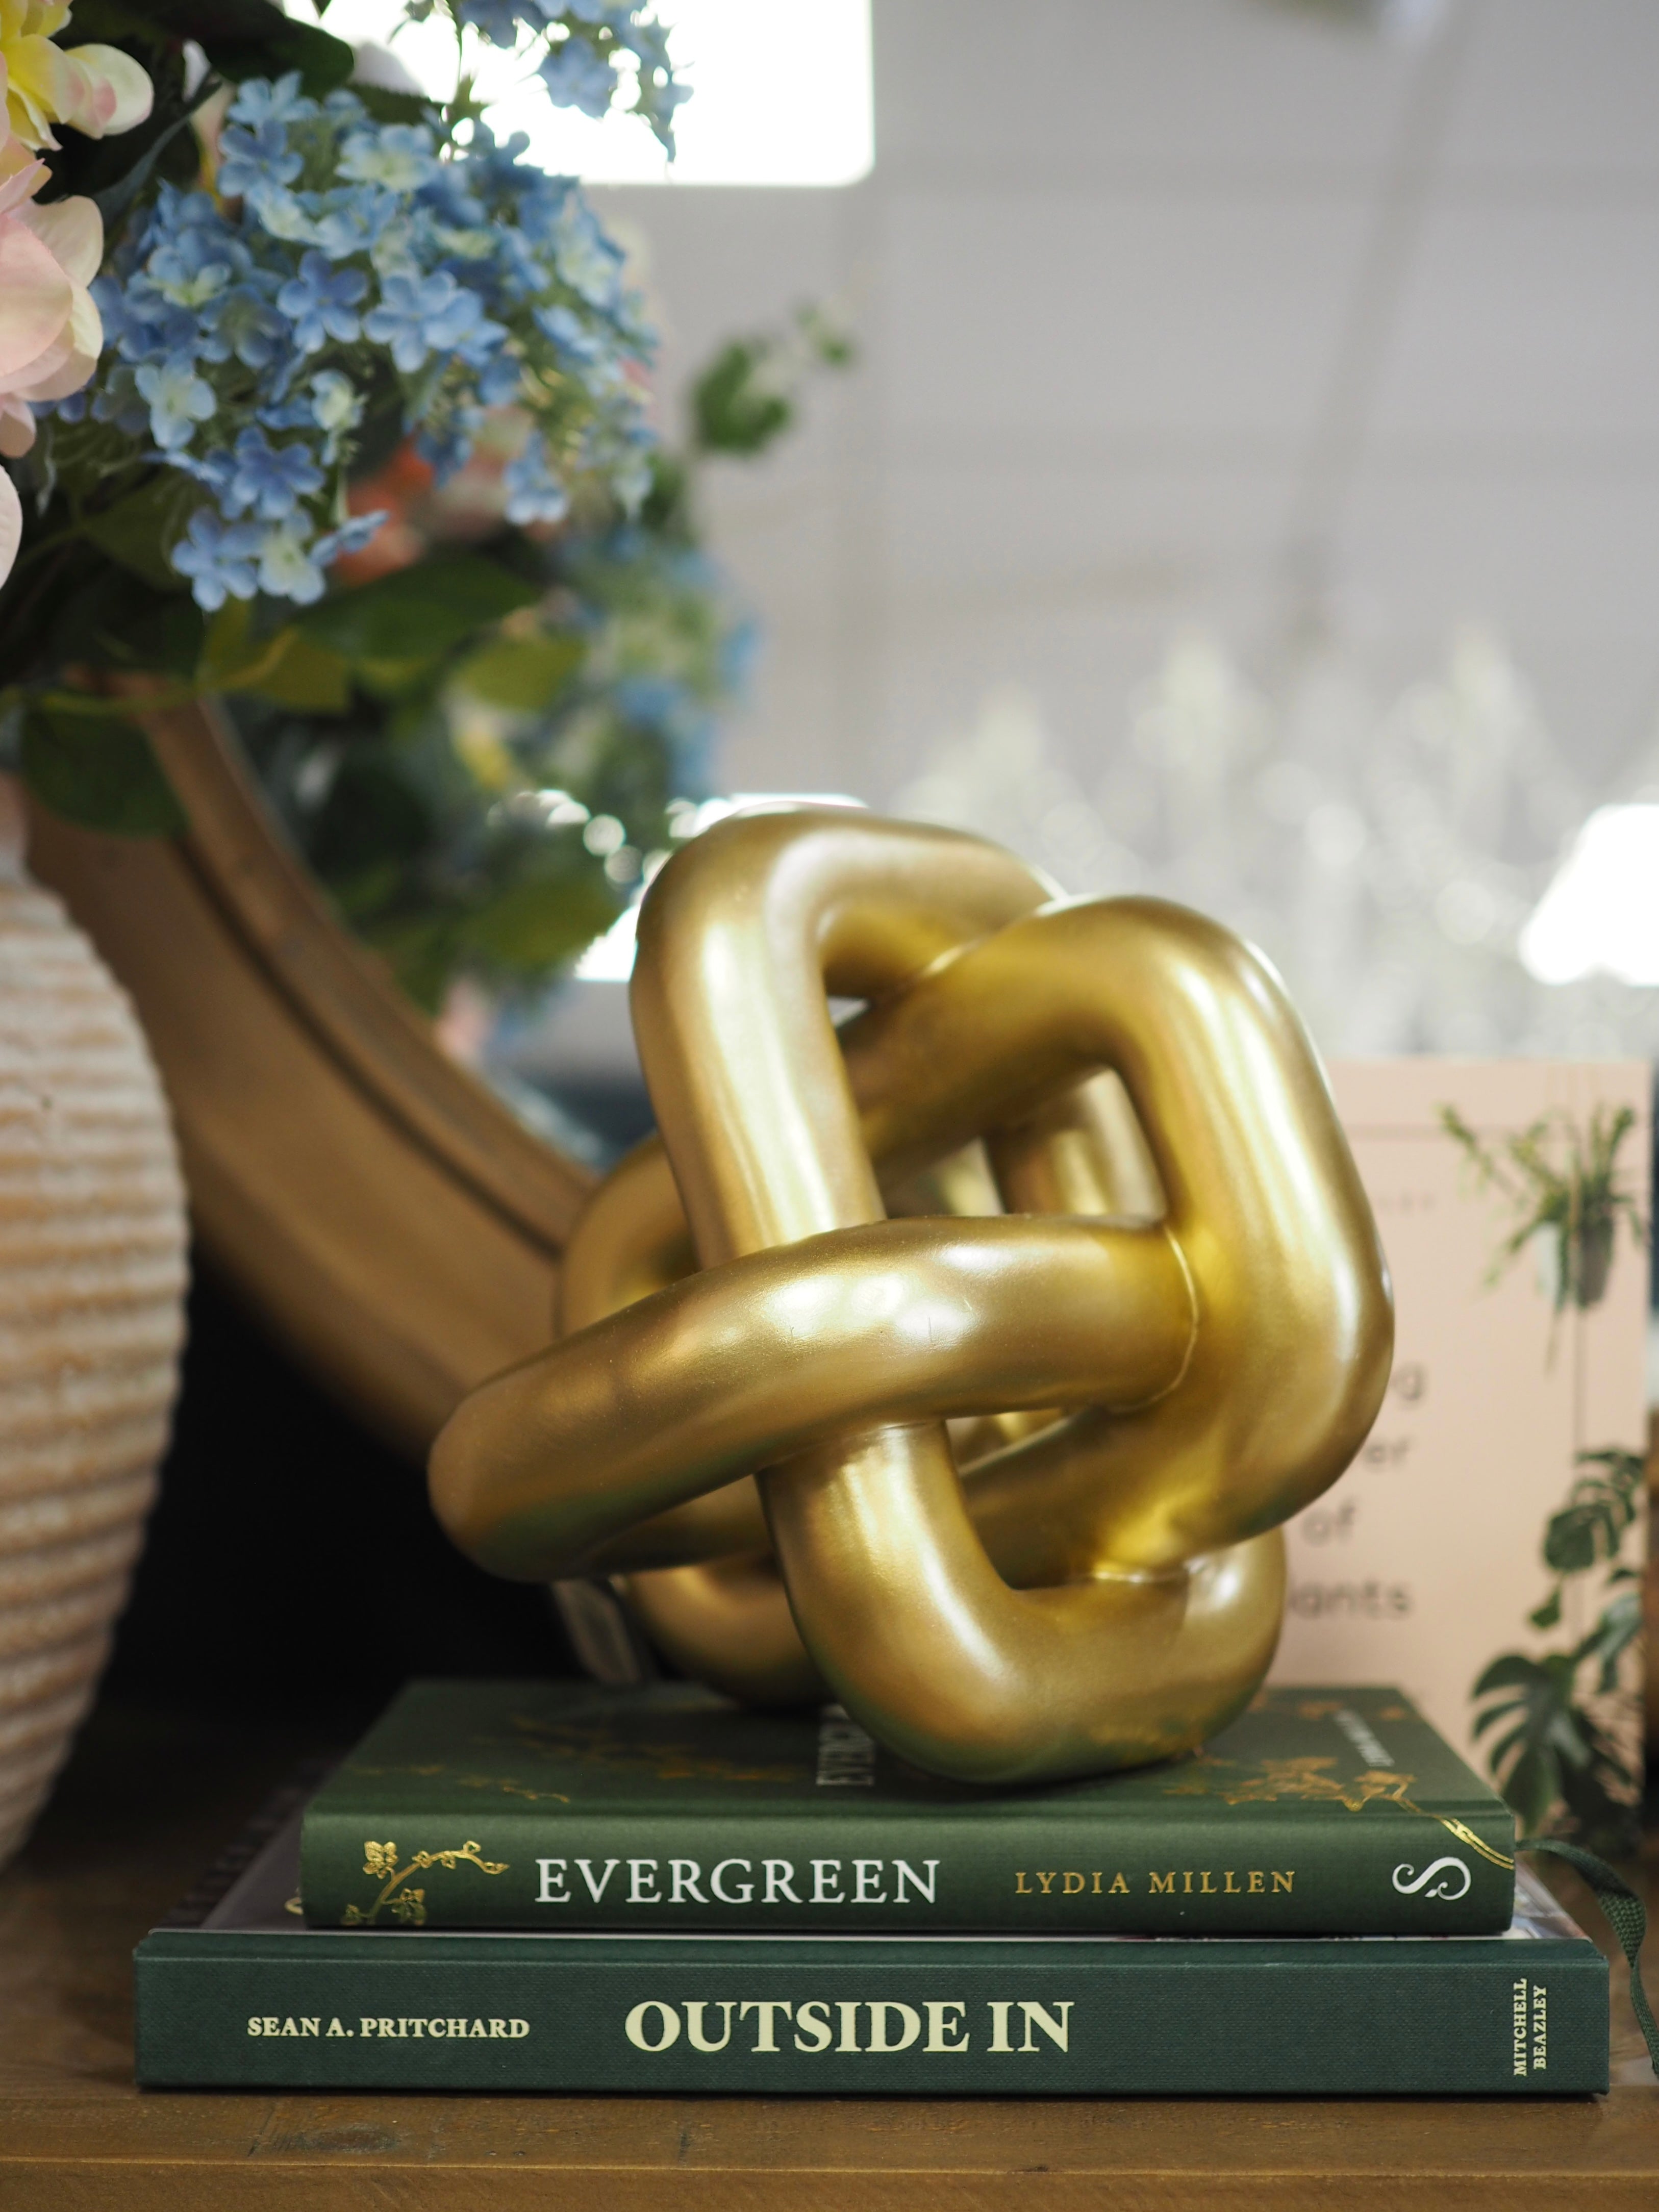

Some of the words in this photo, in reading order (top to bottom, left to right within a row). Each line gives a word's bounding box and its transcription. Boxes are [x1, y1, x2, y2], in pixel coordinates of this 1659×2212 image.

[1289, 1578, 1412, 1620] ants
[535, 1858, 940, 1904] EVERGREEN
[1015, 1871, 1129, 1895] LYDIA
[1149, 1871, 1295, 1894] MILLEN
[247, 2017, 321, 2038] SEAN
[325, 2017, 355, 2038] A.
[359, 2018, 530, 2039] PRITCHARD
[625, 2000, 970, 2053] OUTSIDE
[987, 2001, 1075, 2053] IN
[1513, 1977, 1527, 2076] MITCHELL
[1533, 1984, 1547, 2070] BEAZLEY
